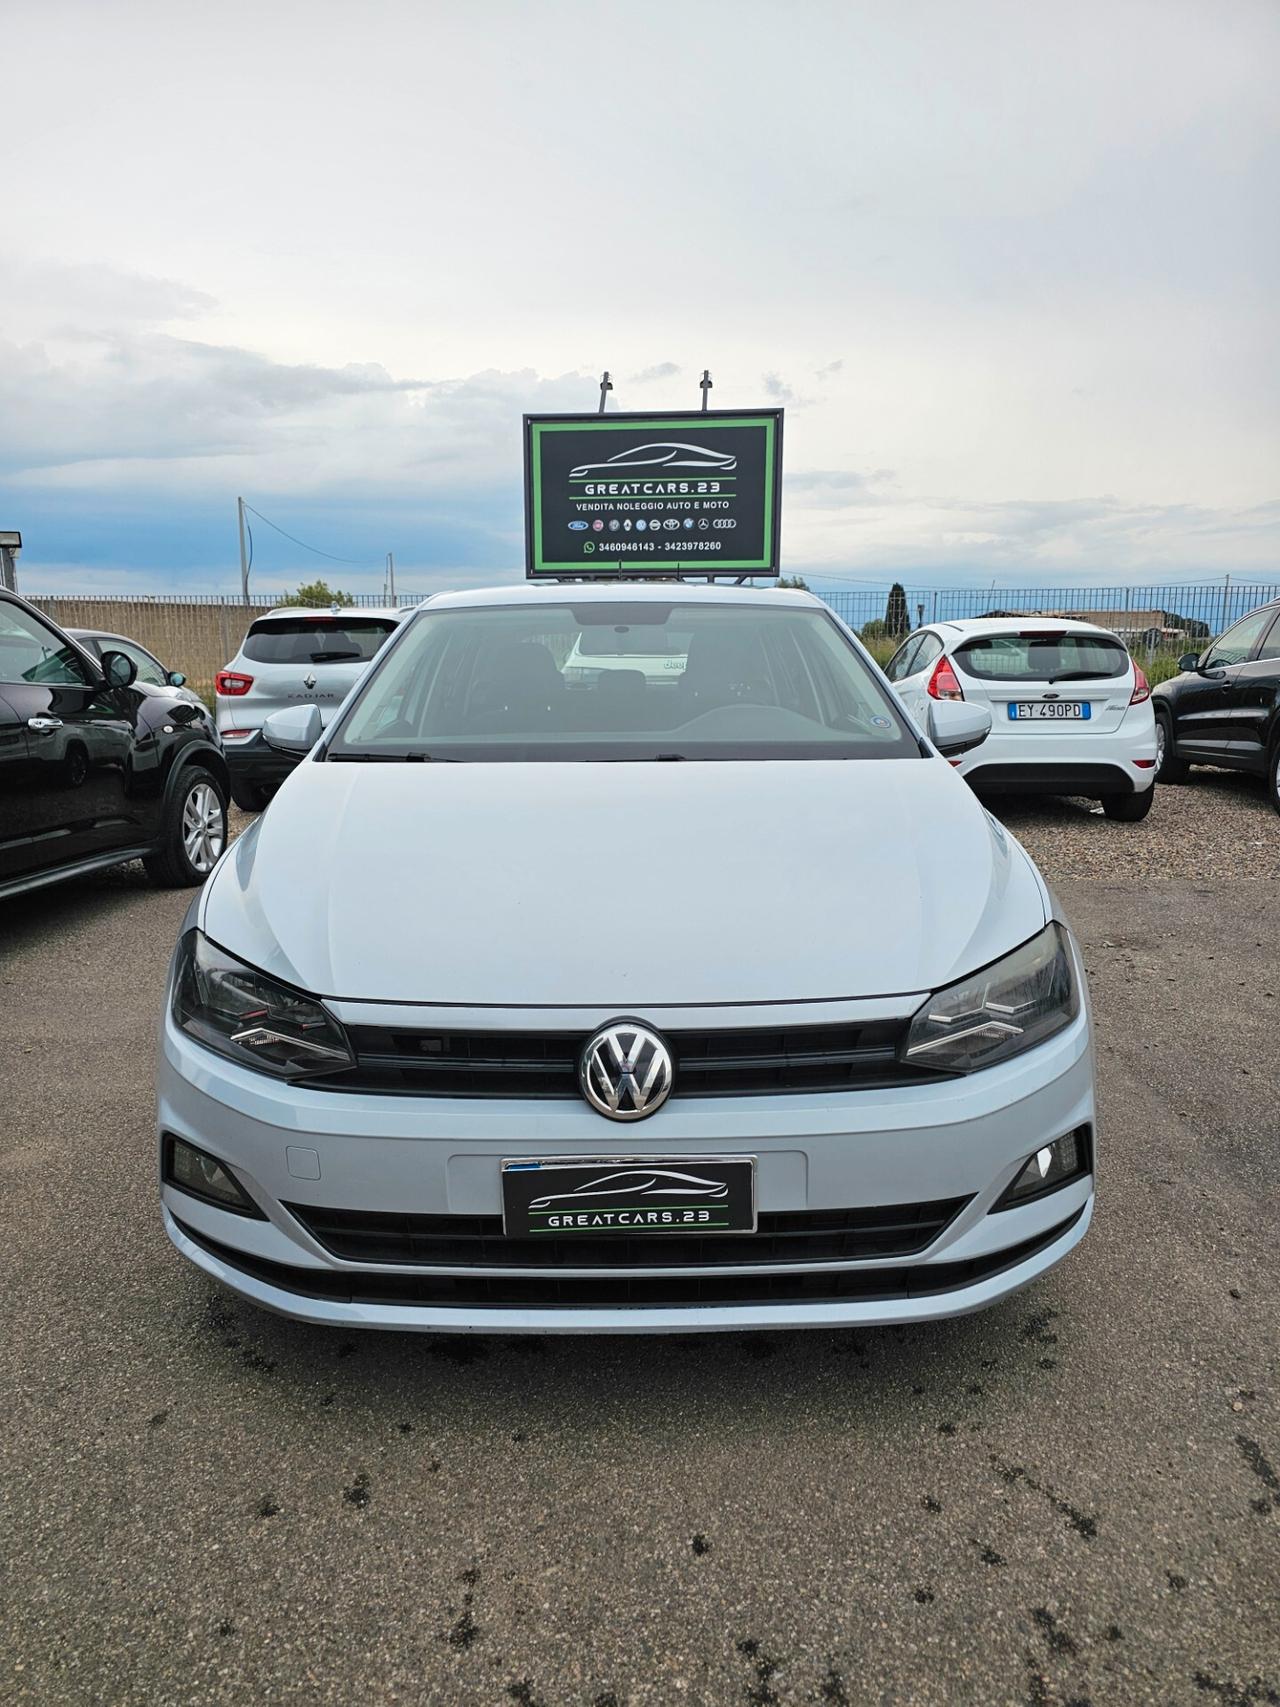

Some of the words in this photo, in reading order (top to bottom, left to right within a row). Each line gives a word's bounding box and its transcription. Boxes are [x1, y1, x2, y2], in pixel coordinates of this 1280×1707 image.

[585, 482, 720, 494] GREATCARS.23
[576, 503, 614, 511] VENDITA
[617, 502, 664, 510] NOLEGGIO
[666, 502, 691, 510] AUTO
[703, 501, 730, 509] MOTO
[599, 542, 655, 551] 3460946143
[664, 541, 722, 551] 3423978260
[1018, 704, 1034, 717] EY
[1040, 704, 1081, 717] 490PD
[548, 1210, 710, 1227] GREATCARS.23
